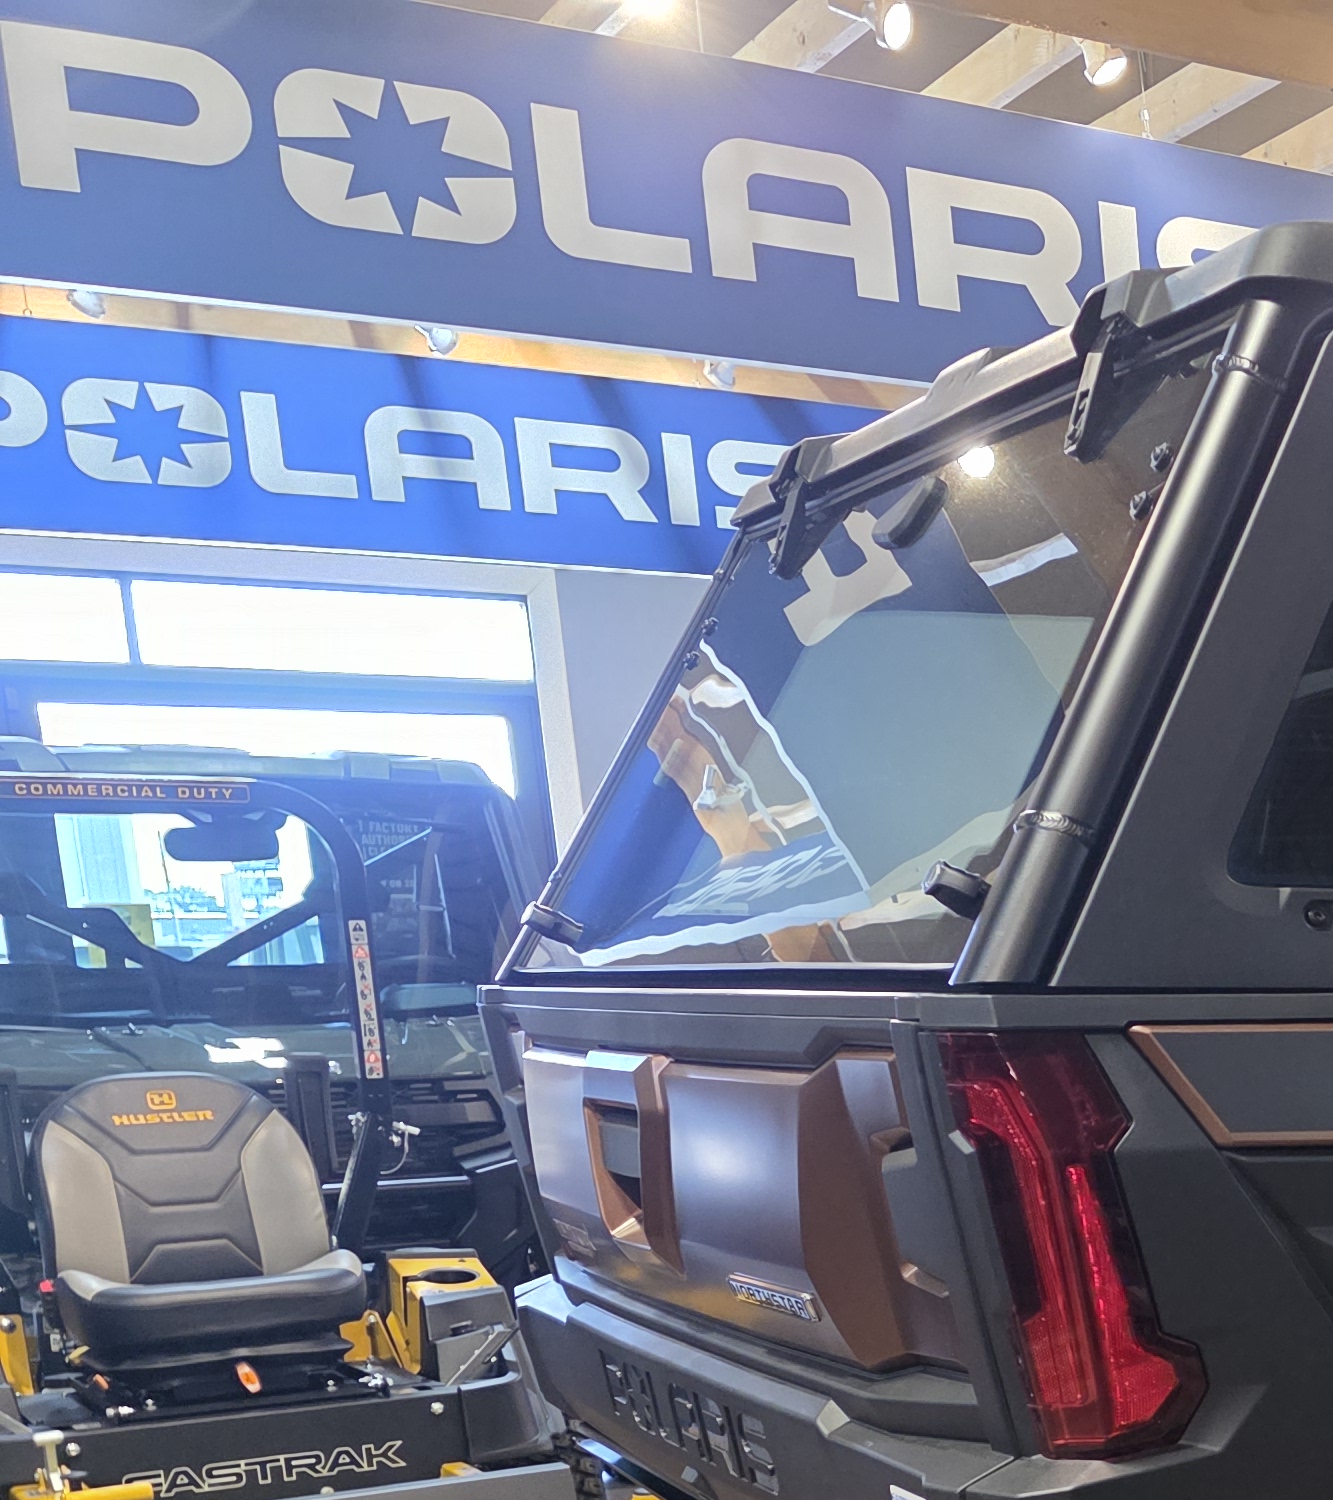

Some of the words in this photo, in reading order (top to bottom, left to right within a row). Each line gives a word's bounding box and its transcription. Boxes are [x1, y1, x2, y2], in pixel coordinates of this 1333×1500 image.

[0, 371, 797, 530] OLARIS
[14, 783, 167, 798] COMMERCIAL
[177, 787, 233, 799] DUTY
[111, 1109, 215, 1126] HUSTLER
[730, 1281, 811, 1319] NORTHSTAR
[598, 1348, 780, 1497] POLARIS
